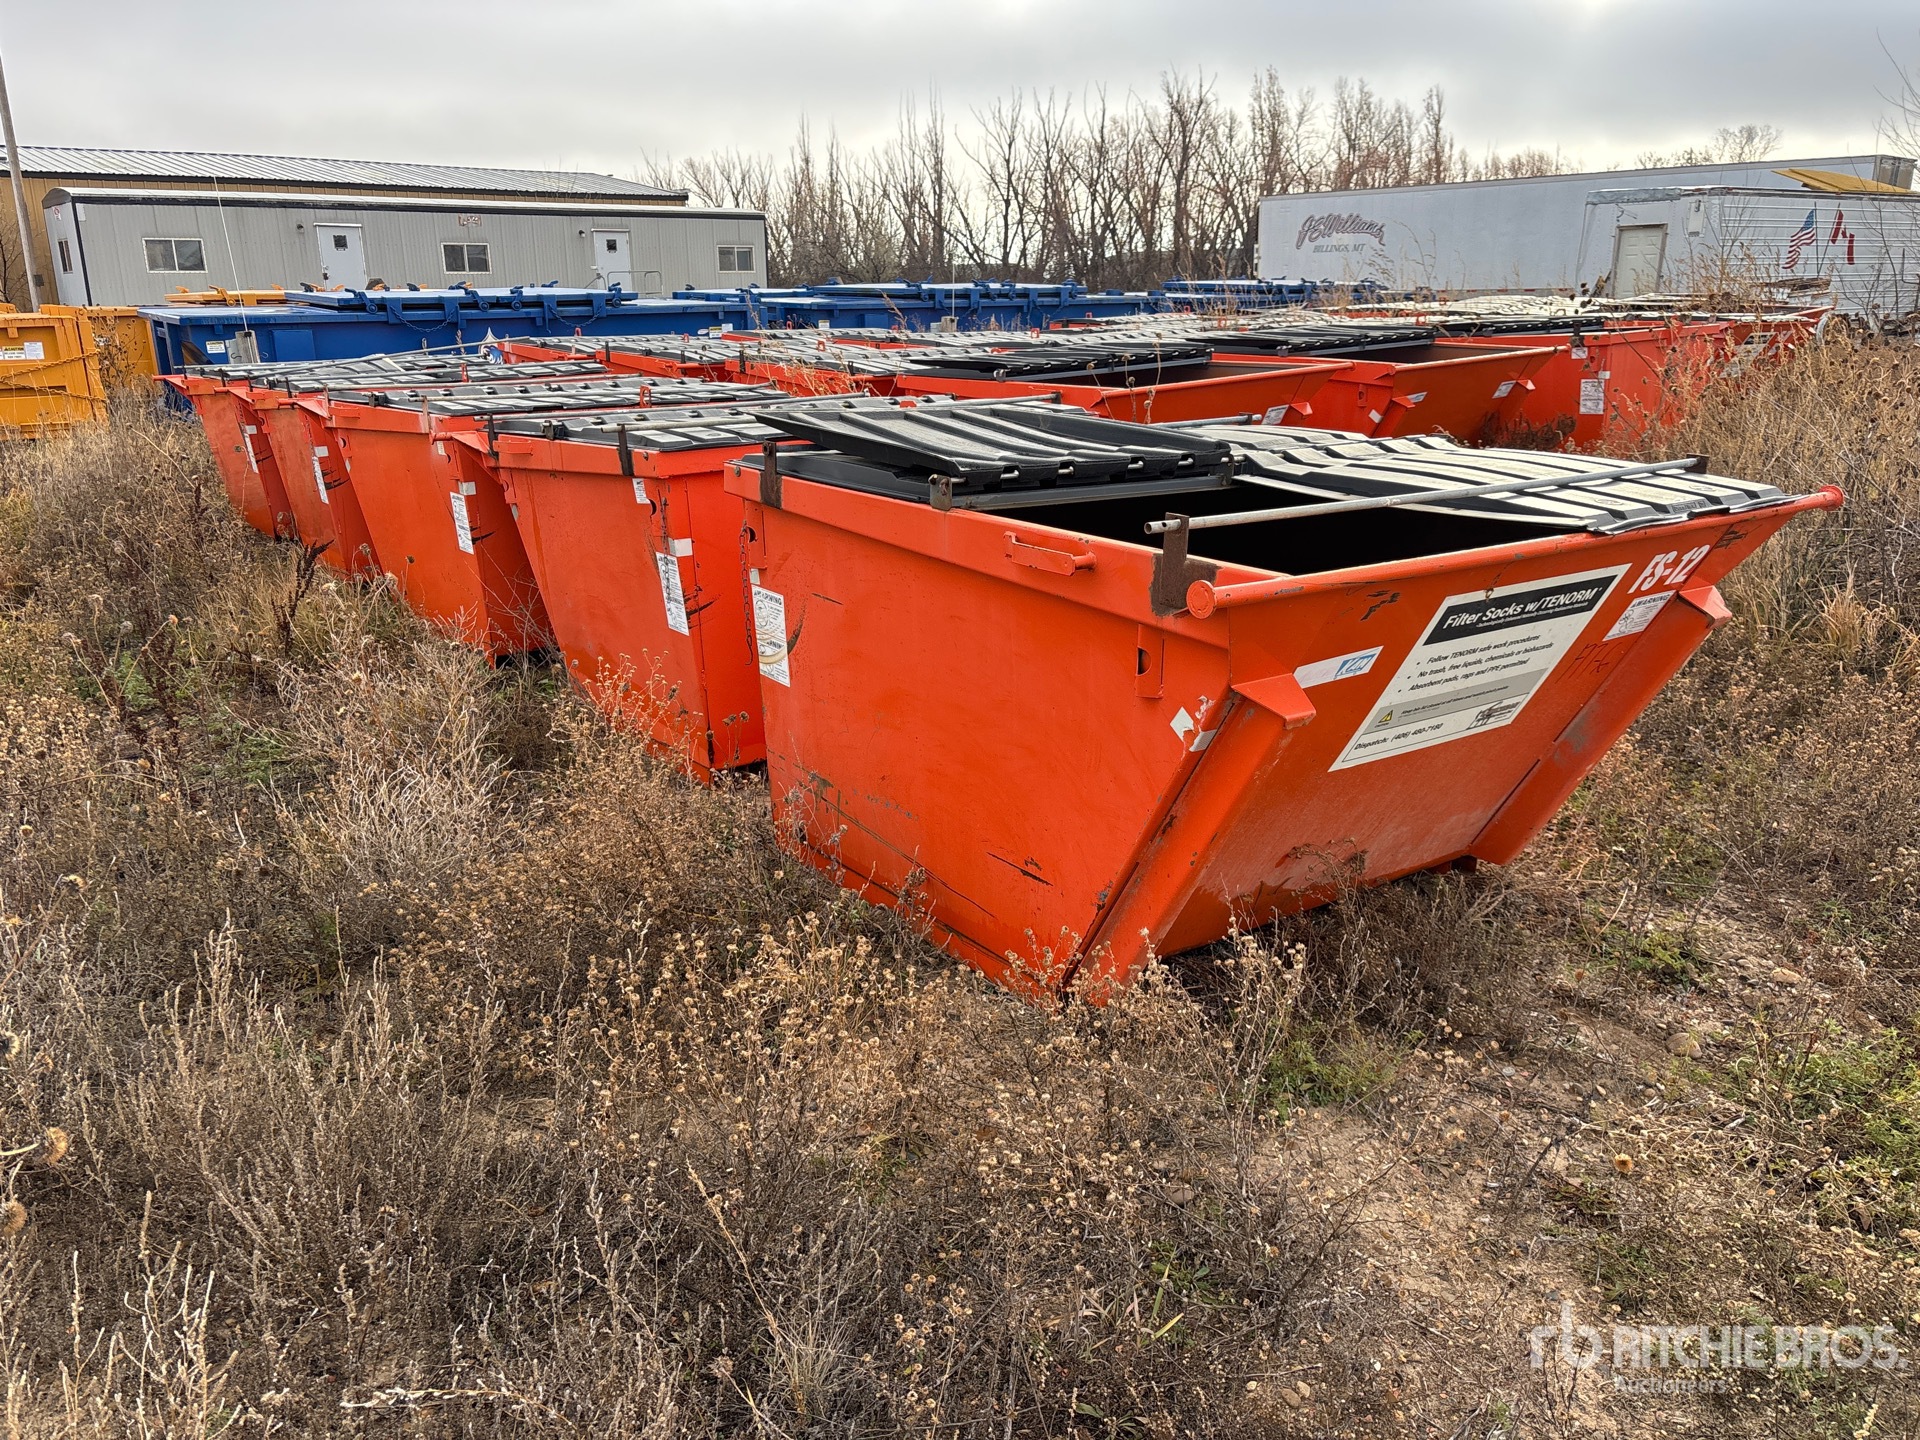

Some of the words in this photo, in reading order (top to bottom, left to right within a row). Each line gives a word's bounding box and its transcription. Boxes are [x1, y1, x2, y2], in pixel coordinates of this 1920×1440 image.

[1313, 244, 1350, 253] BILLINGS,
[1351, 243, 1366, 253] MT
[1627, 544, 1710, 594] FS-12
[1443, 613, 1483, 629] Filter
[1482, 603, 1524, 621] Socks
[1426, 655, 1450, 664] Follow
[1450, 647, 1479, 659] TENORM
[1478, 644, 1492, 653] safe
[1492, 641, 1508, 649] work
[1506, 635, 1541, 648] procedures
[1428, 666, 1446, 676] trash,
[1461, 658, 1483, 668] liquids,
[1484, 651, 1515, 663] chemicals
[1522, 642, 1554, 654] biohazards
[1408, 678, 1443, 691] Absorbent
[1441, 675, 1459, 685] pads,
[1460, 672, 1475, 680] rags
[1475, 668, 1489, 676] and
[1487, 664, 1501, 673] PPE
[1499, 658, 1530, 671] permitted
[1354, 737, 1389, 750] Dispatch:
